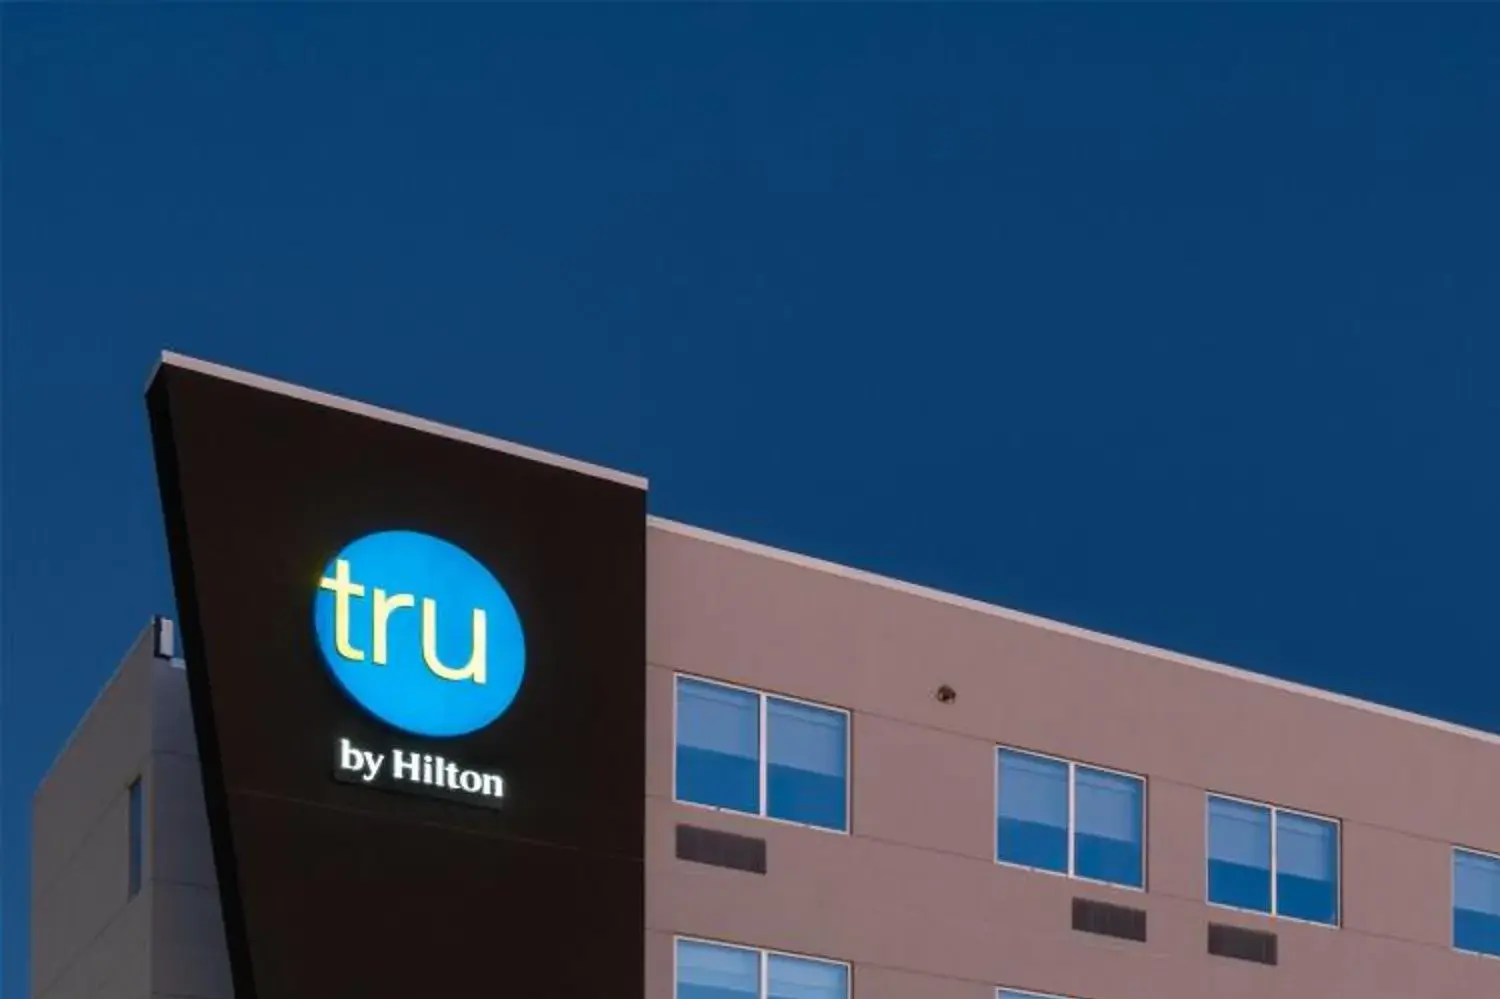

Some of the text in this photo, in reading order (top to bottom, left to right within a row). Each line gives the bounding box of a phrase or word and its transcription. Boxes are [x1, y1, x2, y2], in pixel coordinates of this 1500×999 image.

[320, 558, 486, 684] tru
[340, 738, 504, 797] by Hilton
